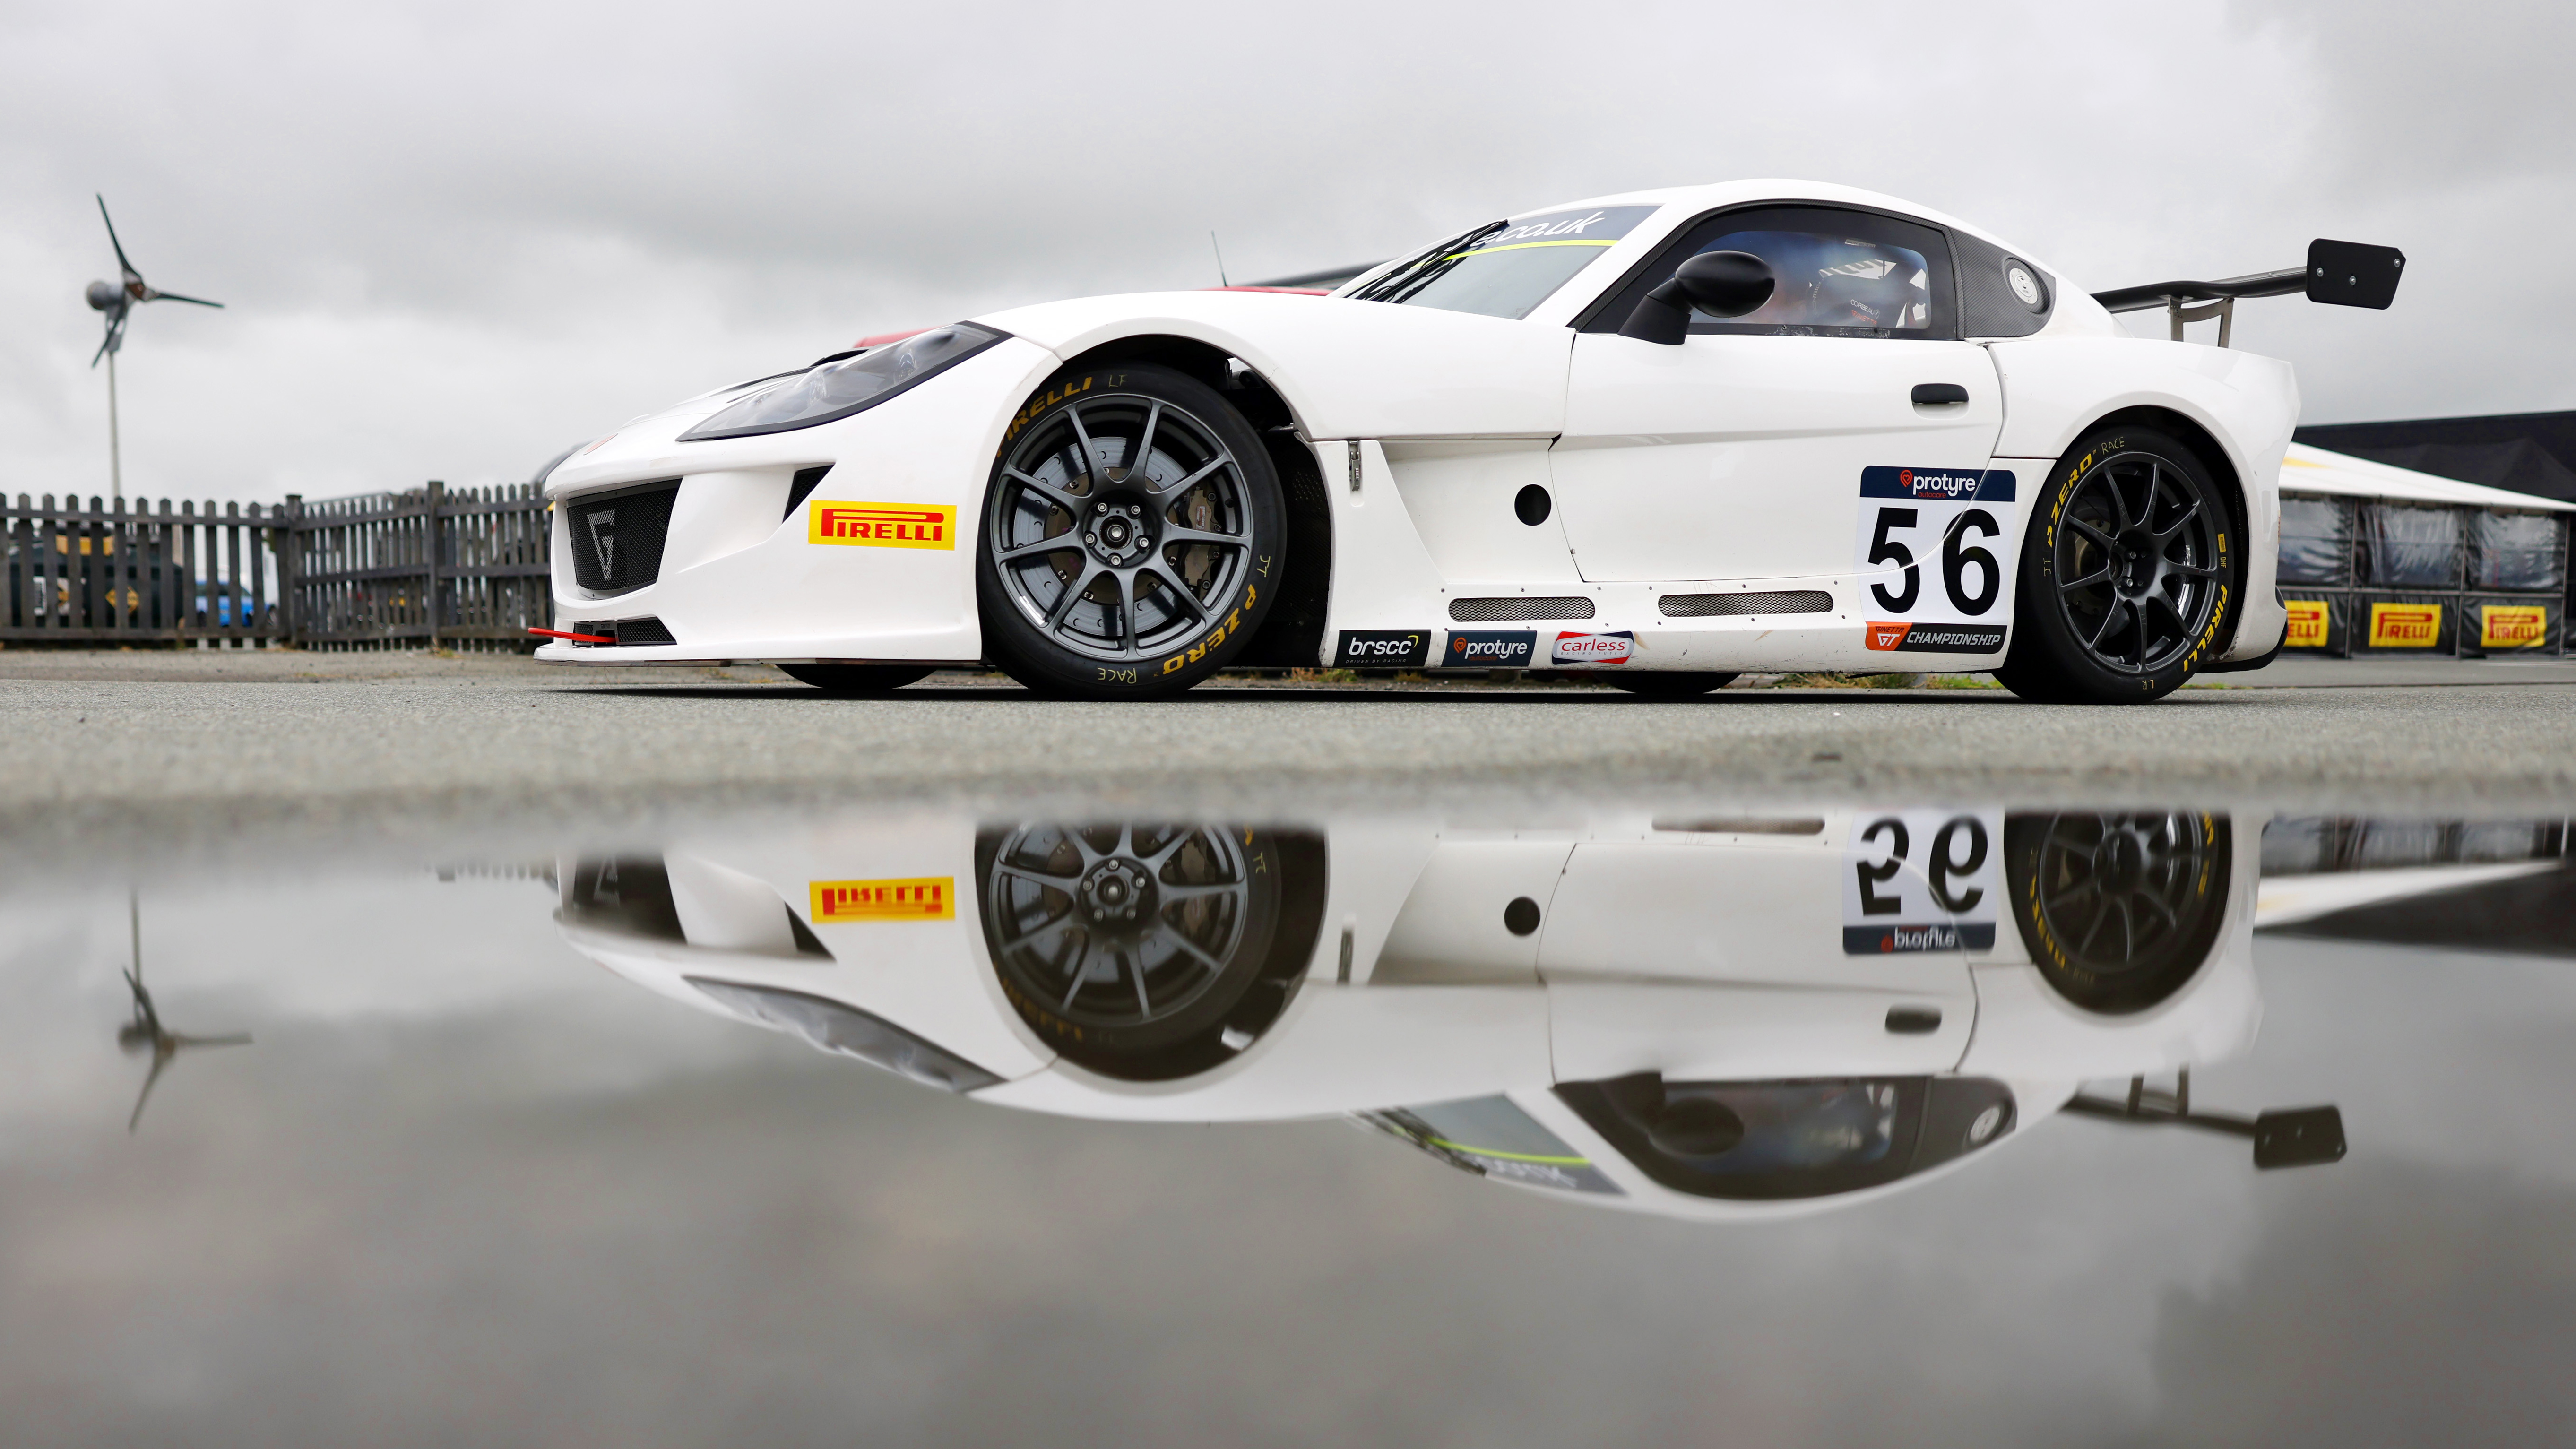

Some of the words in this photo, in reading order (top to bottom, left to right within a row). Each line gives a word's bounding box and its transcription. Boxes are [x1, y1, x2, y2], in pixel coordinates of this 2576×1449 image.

[1850, 299, 1875, 315] CORBEAU
[1109, 374, 1127, 388] LF
[2101, 436, 2125, 455] RACE
[1913, 474, 1976, 497] protyre
[821, 509, 944, 541] PIRELLI
[1868, 507, 2000, 616] 56
[2184, 584, 2228, 672] PIRELLI
[2377, 612, 2433, 638] PIRELLI
[2488, 615, 2538, 640] PIRELLI
[1349, 637, 1412, 655] brscc
[1561, 638, 1625, 651] carless
[1877, 633, 1900, 646] GT
[1907, 632, 2001, 646] CHAMPIONSHIP
[1464, 639, 1527, 659] protyre
[1097, 667, 1137, 684] RACE
